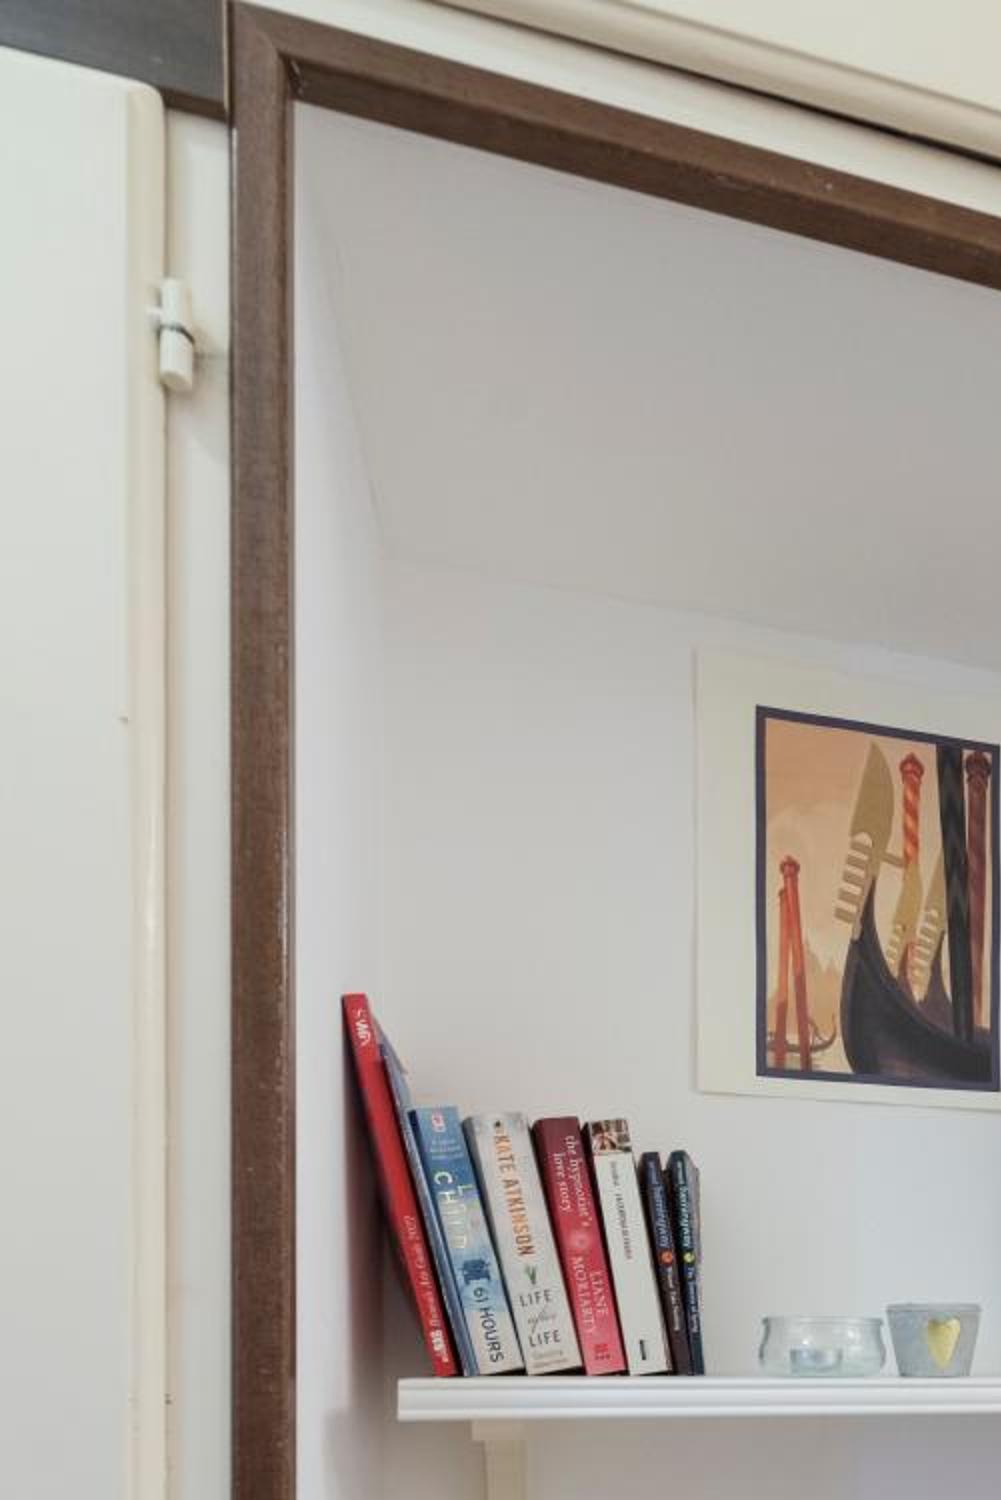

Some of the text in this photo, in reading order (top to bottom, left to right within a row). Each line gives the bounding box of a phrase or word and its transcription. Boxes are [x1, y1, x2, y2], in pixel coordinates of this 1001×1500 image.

[494, 1134, 535, 1258] KATE ATKINSON
[553, 1152, 570, 1214] love story
[519, 1288, 553, 1308] LIFE
[571, 1256, 596, 1336] MORIARTY
[589, 1270, 610, 1316] LIANE
[479, 1308, 506, 1364] HOURS
[528, 1328, 562, 1348] LIFE
